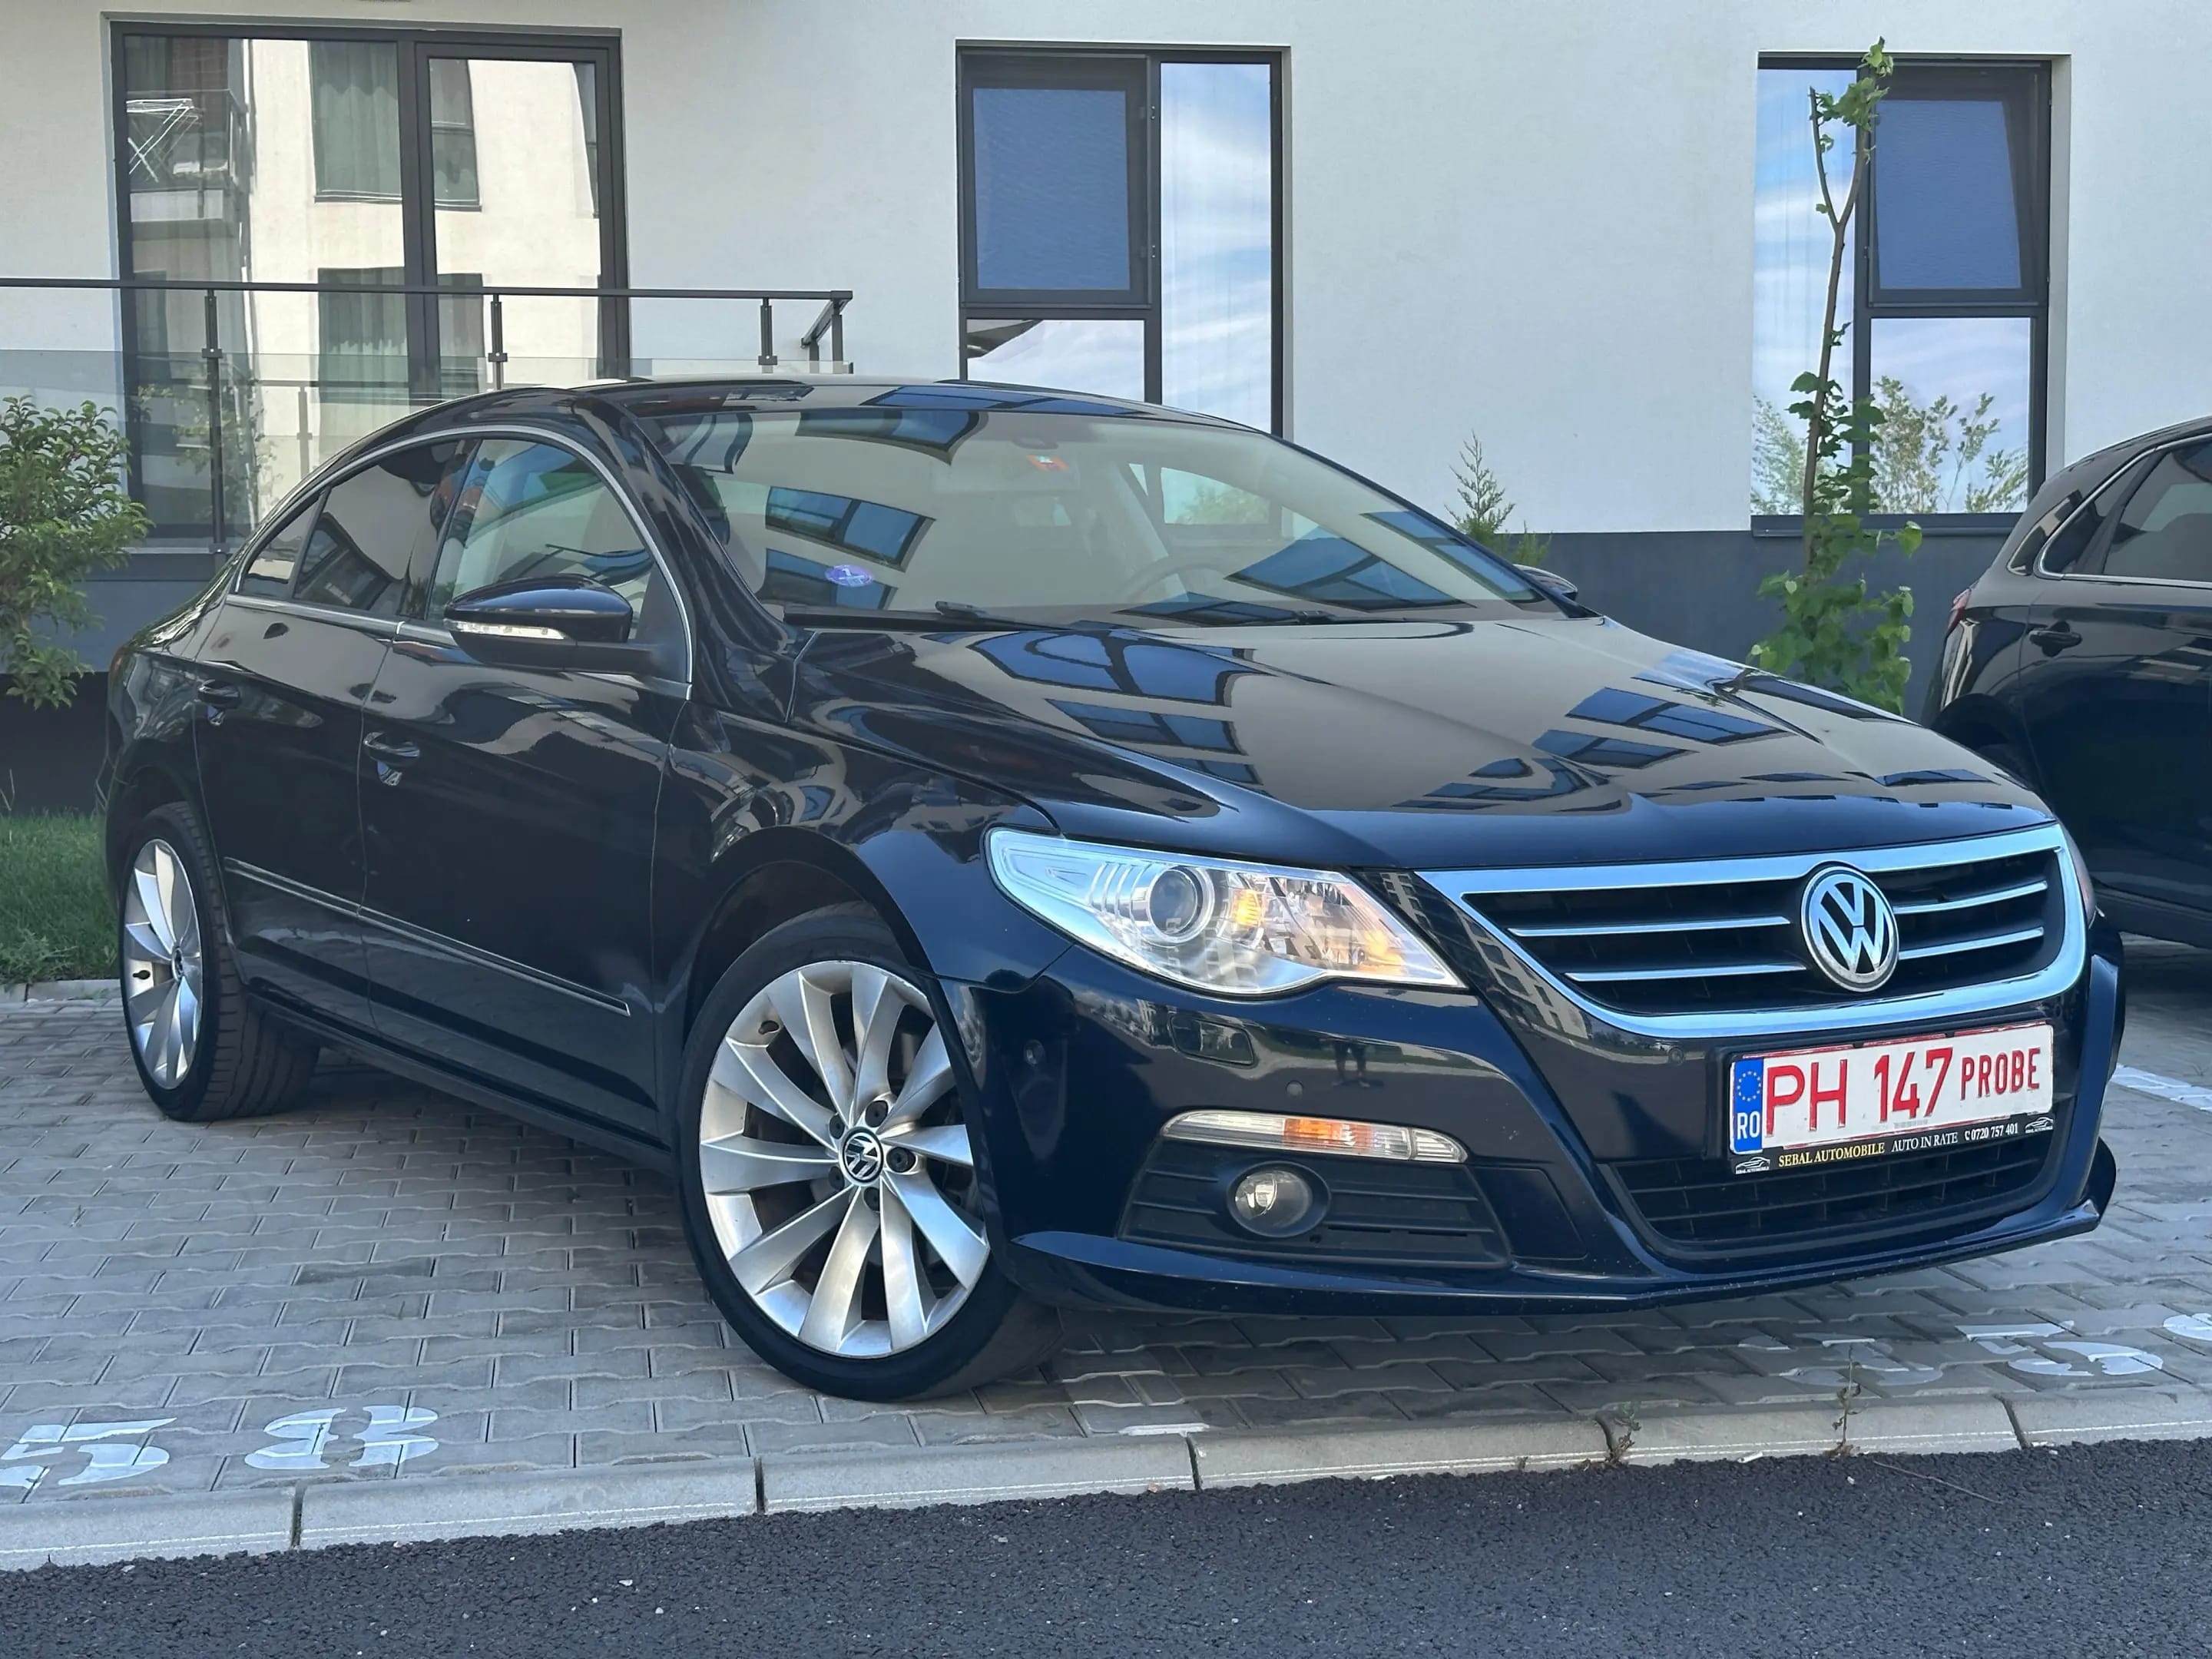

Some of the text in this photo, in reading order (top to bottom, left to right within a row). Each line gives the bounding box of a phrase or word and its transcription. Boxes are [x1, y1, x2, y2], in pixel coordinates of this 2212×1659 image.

[1807, 873, 1895, 985] VW
[1737, 1110, 1761, 1141] RO
[1766, 1047, 2041, 1137] PH 147 PROBE
[1778, 1153, 1813, 1167] SEBAL
[1815, 1142, 1886, 1163] AUTOMOBILE
[1891, 1138, 1919, 1152] AUTO
[1920, 1137, 1933, 1148] IN
[1934, 1132, 1958, 1146] RATE
[1971, 1127, 1988, 1141] 0720
[1991, 1124, 2004, 1137] 757
[2005, 1122, 2018, 1136] 401
